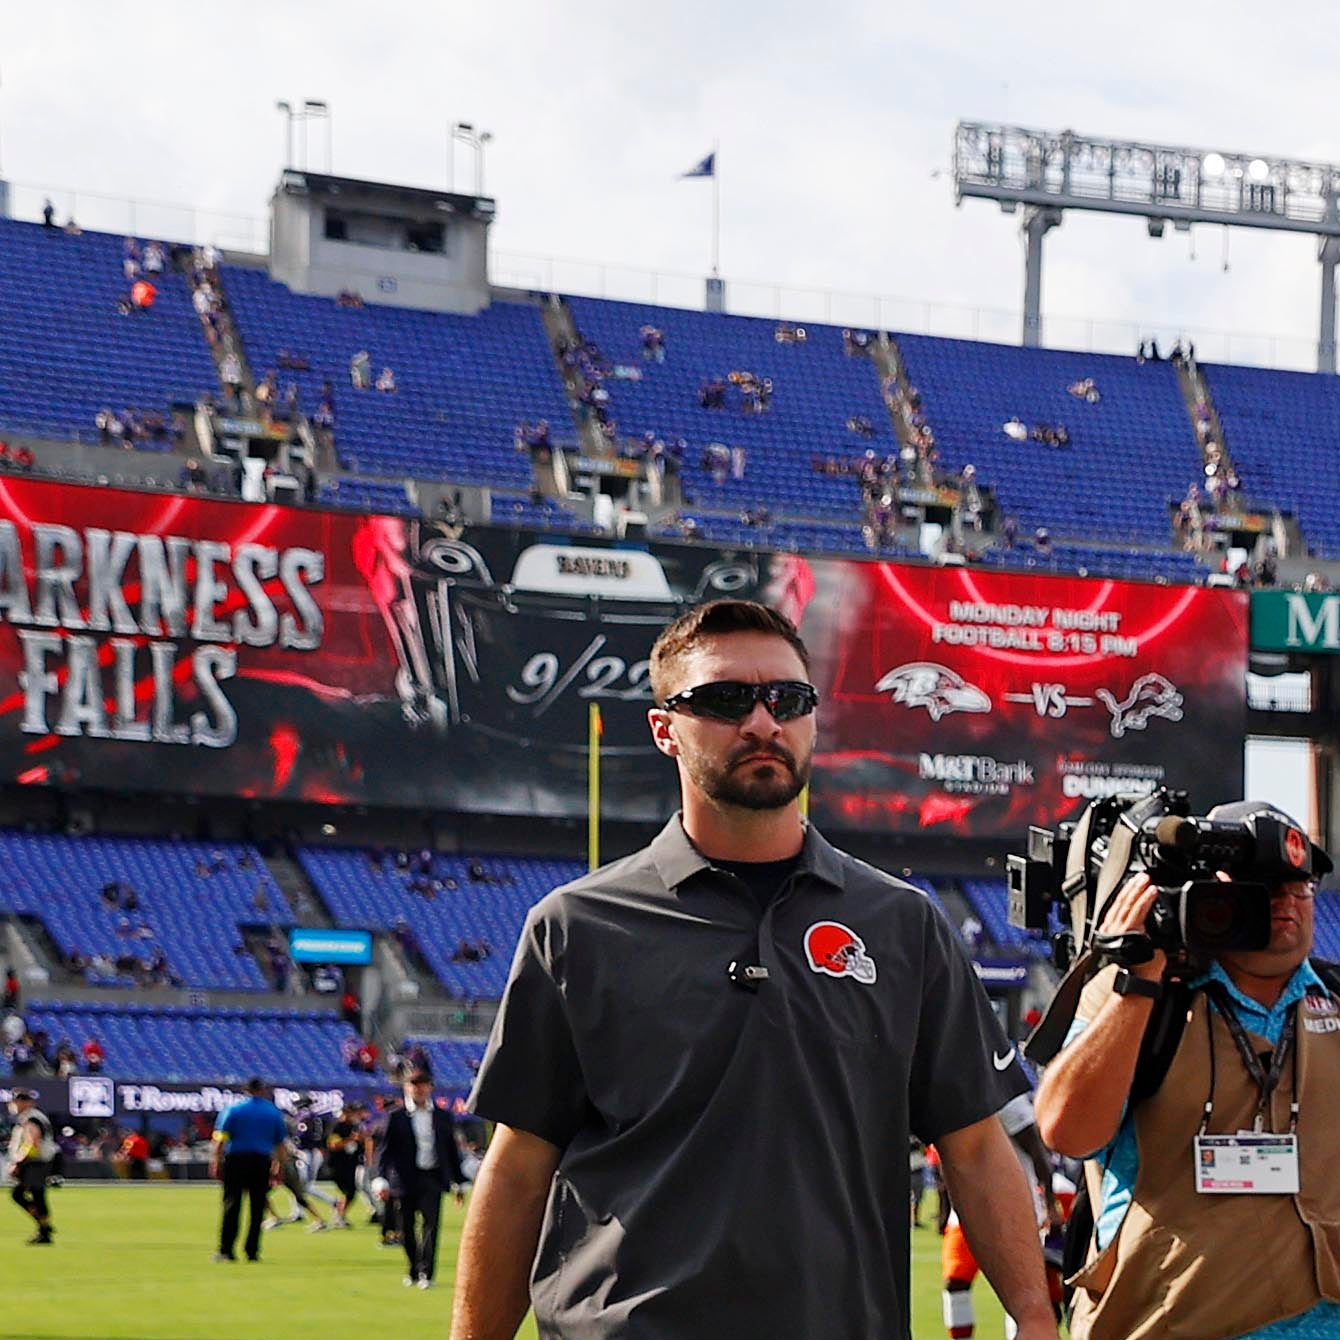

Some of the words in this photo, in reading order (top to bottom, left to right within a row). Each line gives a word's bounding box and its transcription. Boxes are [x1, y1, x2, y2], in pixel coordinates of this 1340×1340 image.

[0, 518, 325, 651] ARKNESS
[949, 600, 1049, 627] MONDAY
[1052, 607, 1122, 633] NIGHT
[931, 622, 1043, 651] FOOTBALL
[1046, 632, 1097, 654] 8:15
[1101, 635, 1139, 658] PM
[17, 629, 239, 749] FALLS
[918, 752, 976, 781] M&T
[977, 755, 1036, 786] Bank
